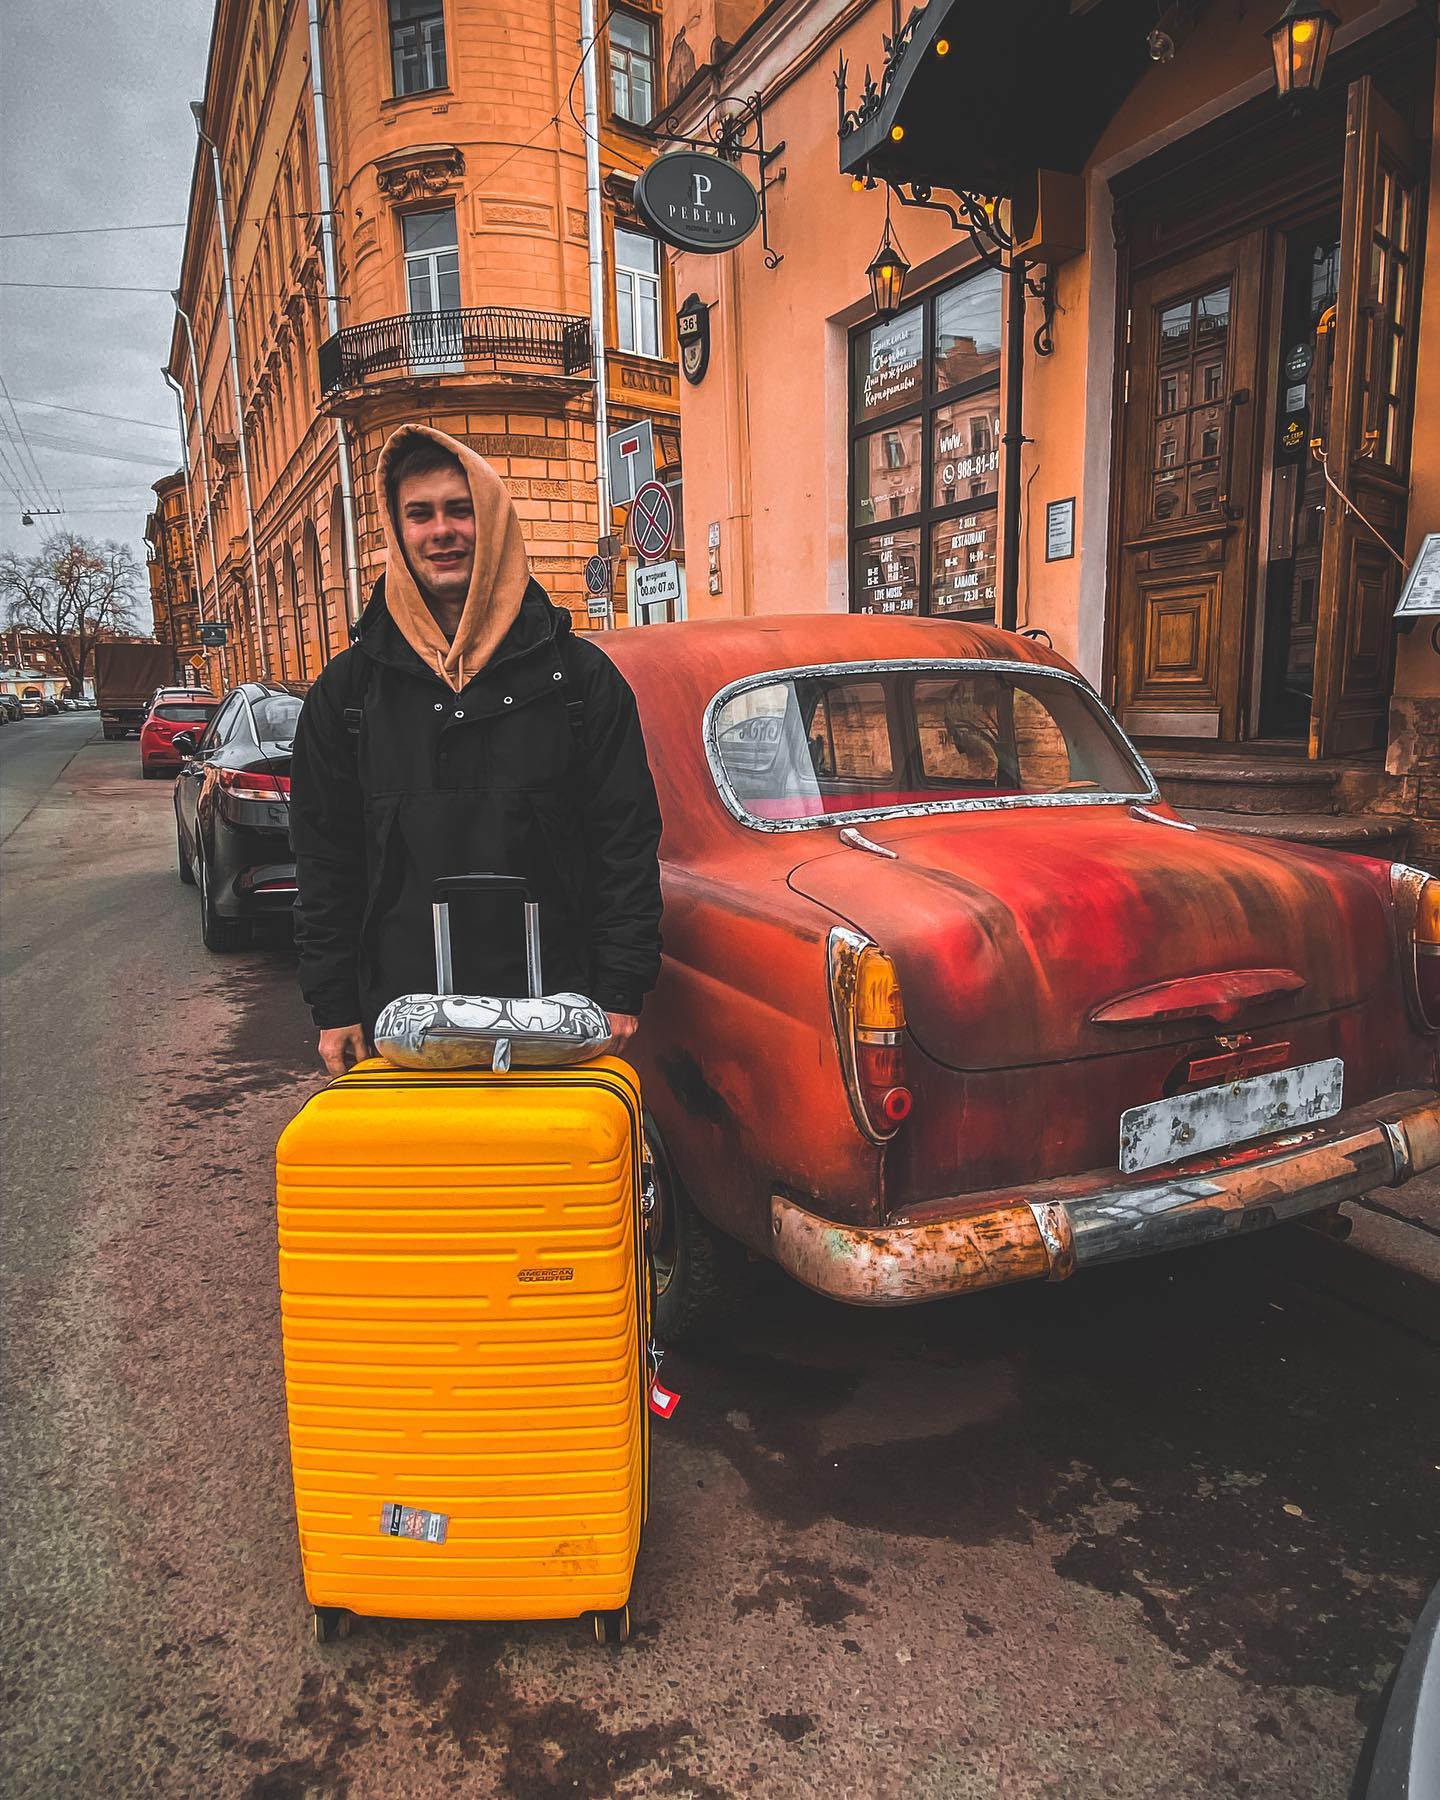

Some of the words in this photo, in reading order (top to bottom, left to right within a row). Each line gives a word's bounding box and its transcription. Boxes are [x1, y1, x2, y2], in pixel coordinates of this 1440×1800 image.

[692, 173, 712, 207] Р
[669, 204, 737, 226] РЕВЕНЬ
[683, 318, 694, 331] 36
[873, 347, 907, 372] Свадьбы
[863, 375, 879, 394] Дни
[880, 359, 918, 387] рождения
[865, 377, 915, 408] Корпоративы
[940, 432, 963, 454] www.
[951, 530, 987, 549] RESTAURANT
[880, 550, 893, 563] CAFE
[954, 573, 979, 589] KARAOKE
[874, 589, 885, 601] LIVE
[886, 586, 903, 599] MUSIC
